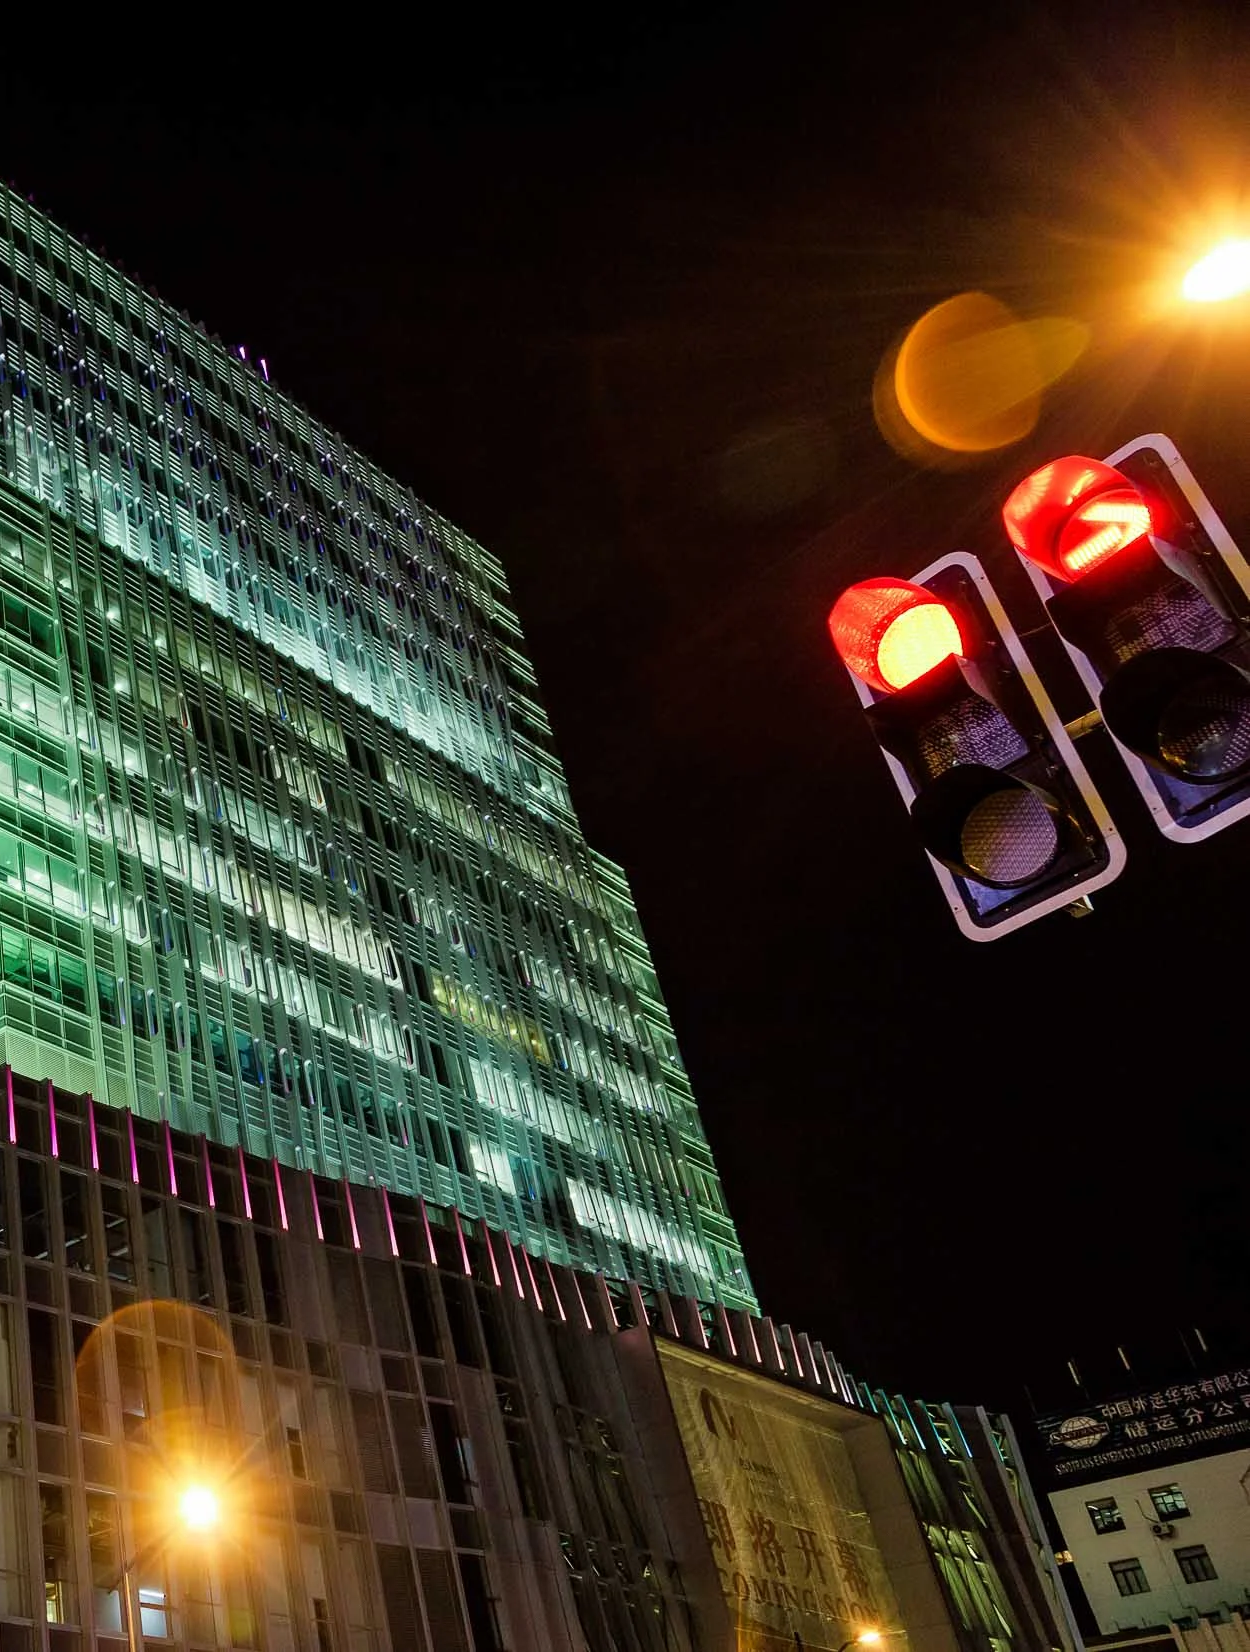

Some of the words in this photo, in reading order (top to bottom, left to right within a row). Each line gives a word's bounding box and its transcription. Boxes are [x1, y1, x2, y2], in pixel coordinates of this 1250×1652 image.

[1102, 1368, 1250, 1417] 中国外运华东有限公
